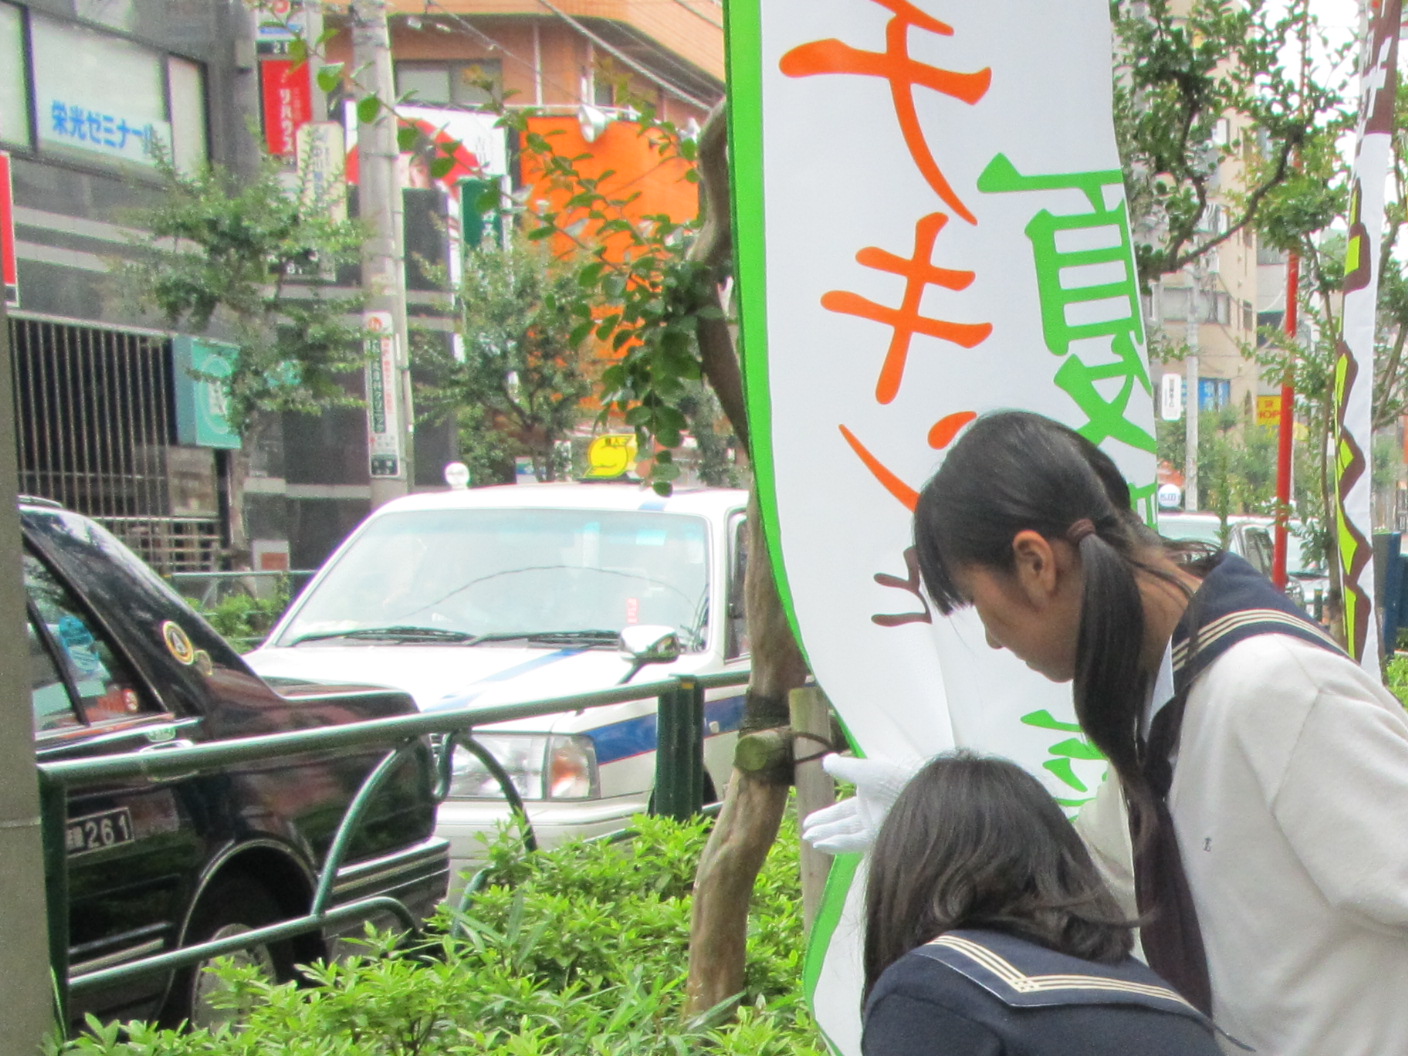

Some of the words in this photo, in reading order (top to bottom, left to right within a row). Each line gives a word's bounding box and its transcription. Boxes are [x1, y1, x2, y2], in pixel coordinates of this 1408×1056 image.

[51, 99, 155, 155] 栄光ゼミナール
